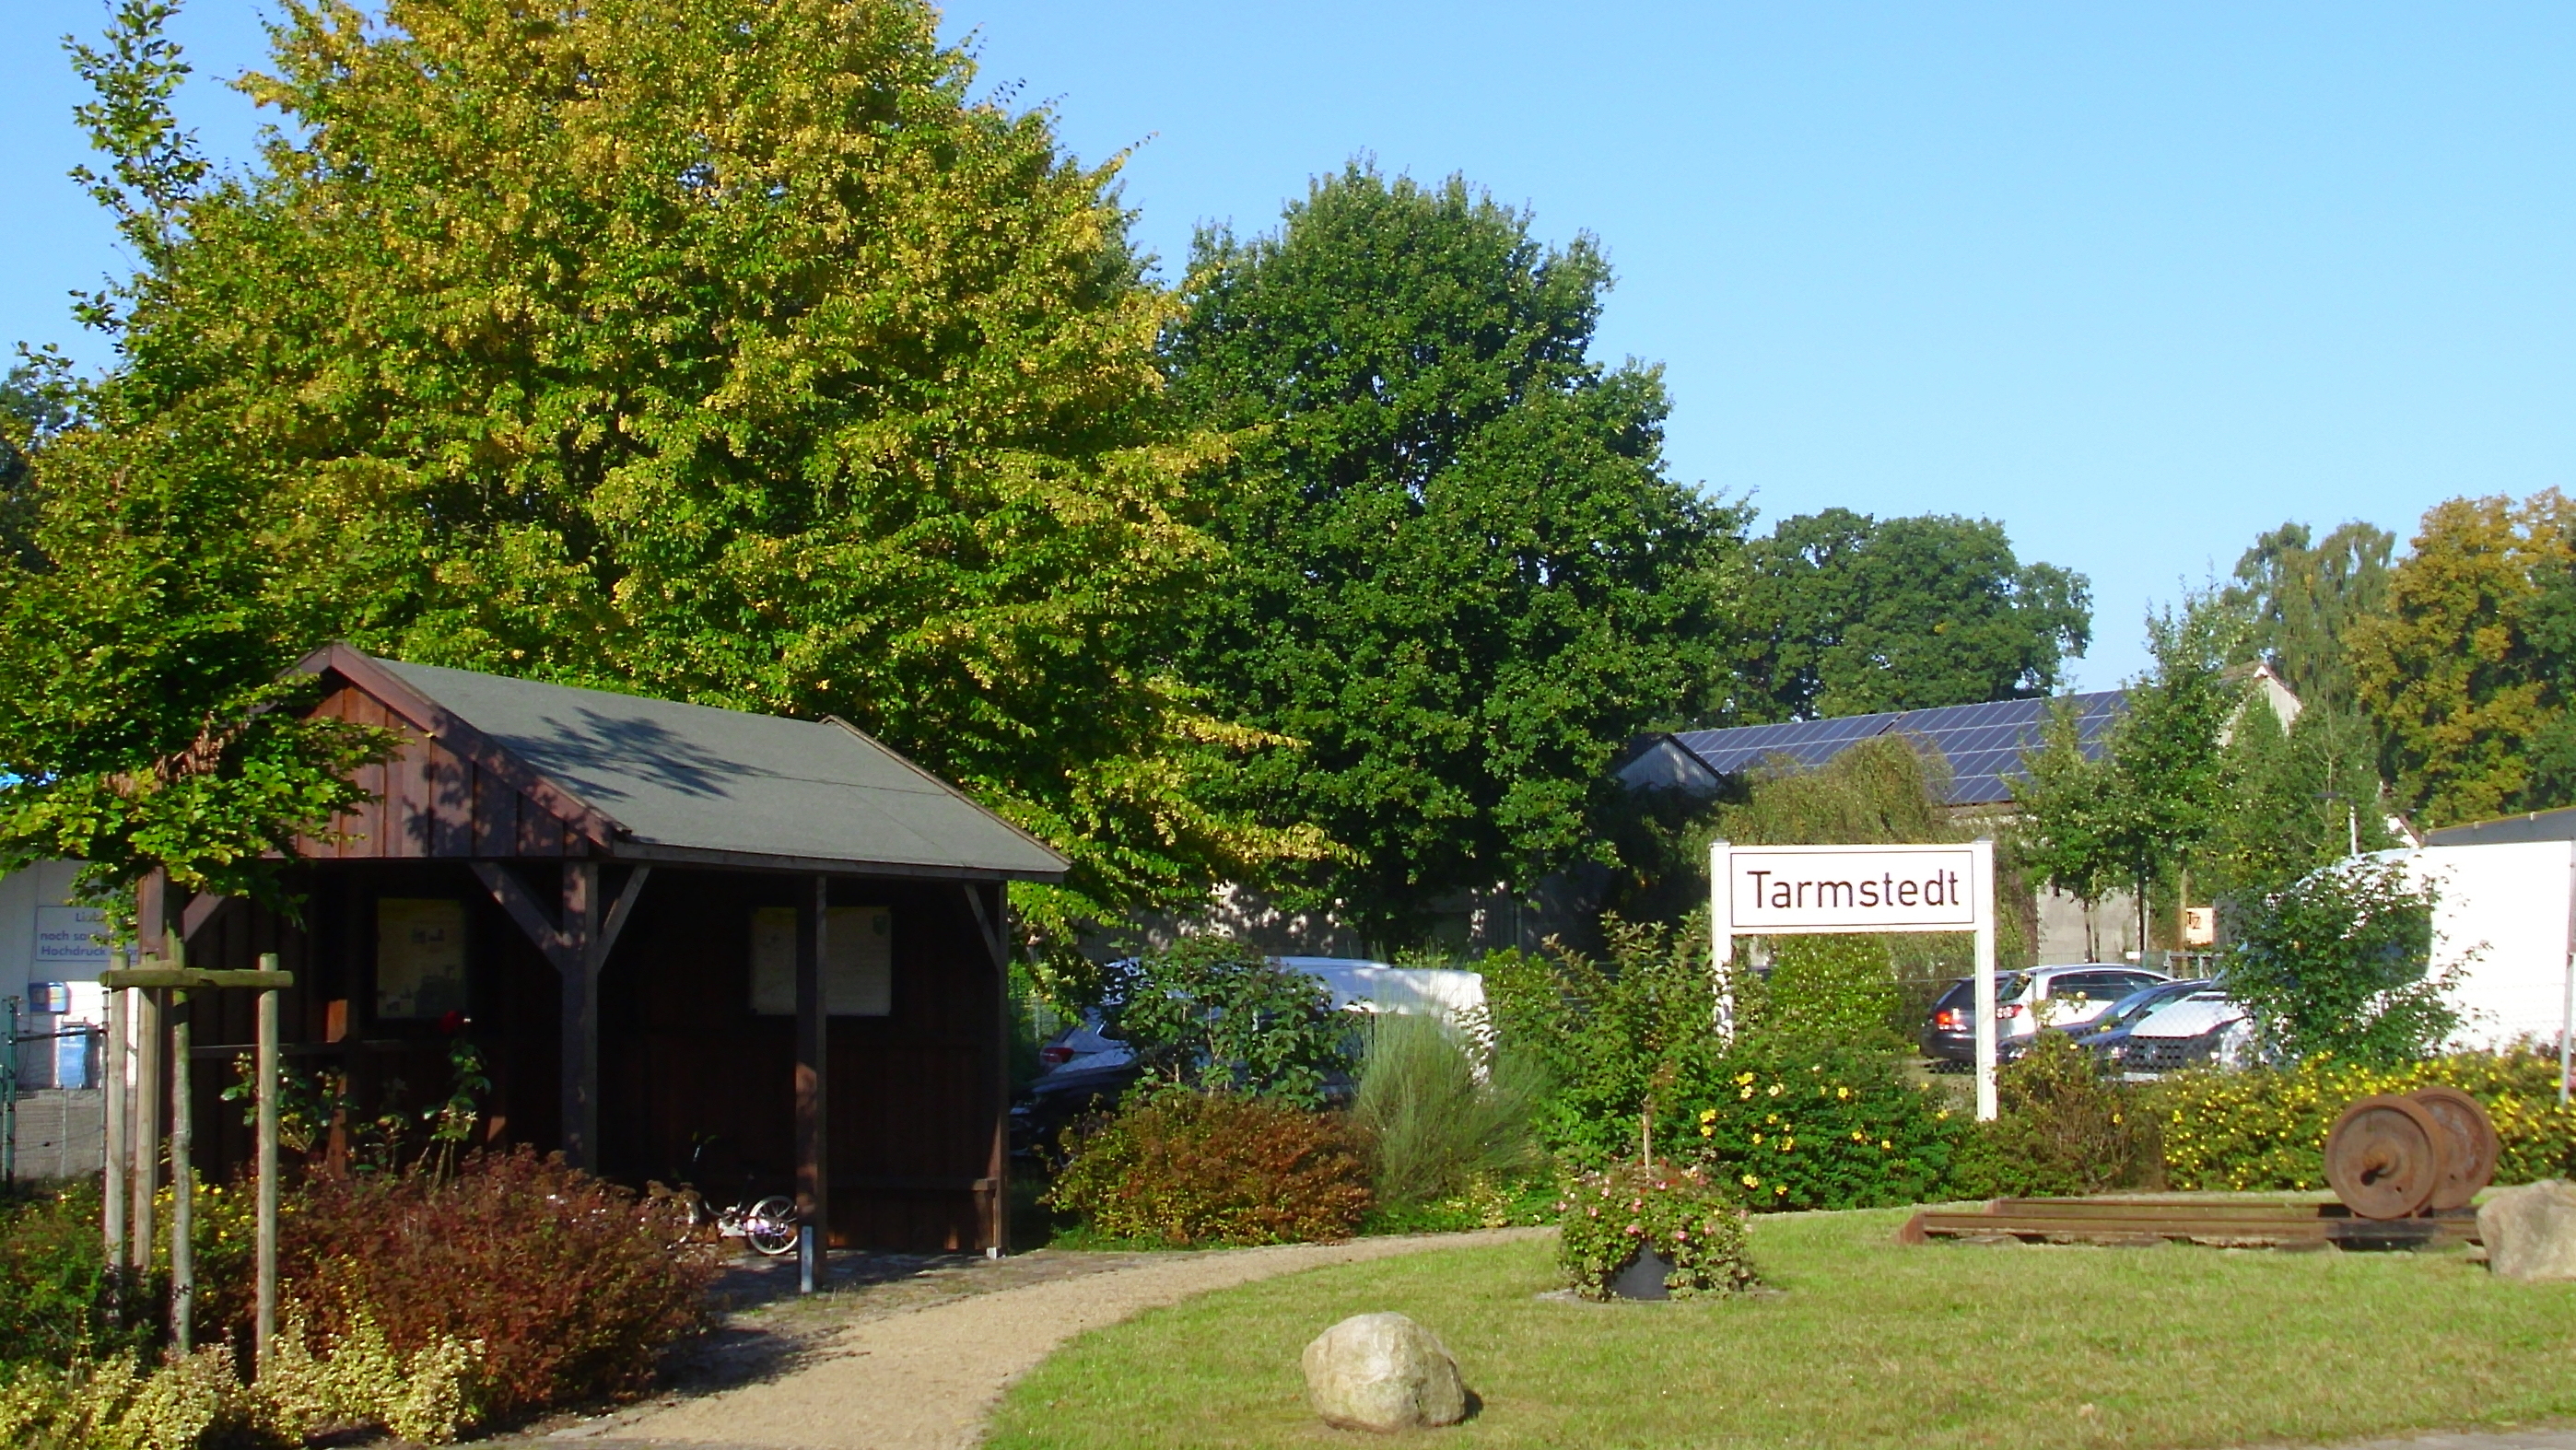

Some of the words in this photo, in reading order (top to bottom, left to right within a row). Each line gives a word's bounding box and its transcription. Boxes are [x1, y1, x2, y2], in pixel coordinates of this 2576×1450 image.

[1747, 869, 1960, 908] Tarmstedt
[41, 930, 69, 941] noch
[41, 945, 106, 956] Hochdruck
